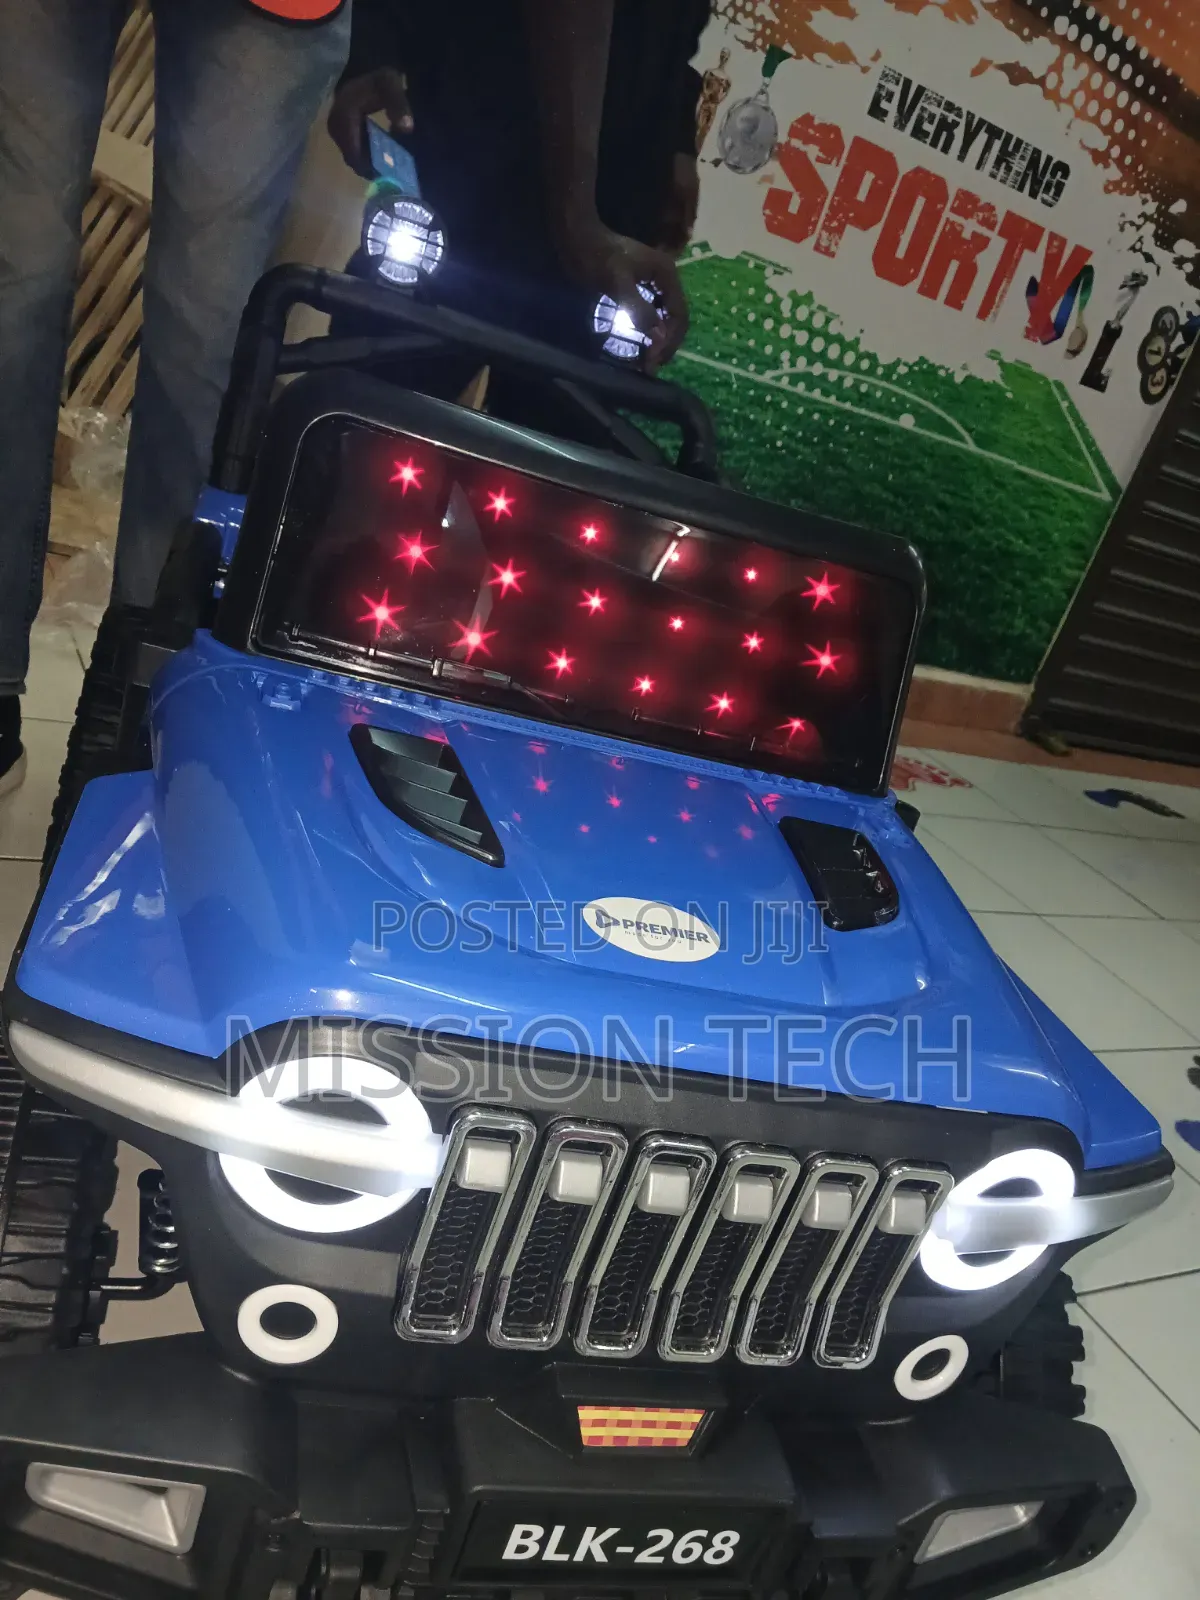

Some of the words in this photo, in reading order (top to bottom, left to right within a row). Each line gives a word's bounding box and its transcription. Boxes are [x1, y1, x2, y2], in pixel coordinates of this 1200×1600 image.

[867, 65, 1071, 208] EVERYTHING
[762, 112, 1093, 345] SPORTY
[622, 918, 711, 944] PREMIER
[501, 1523, 741, 1565] BLK-268
